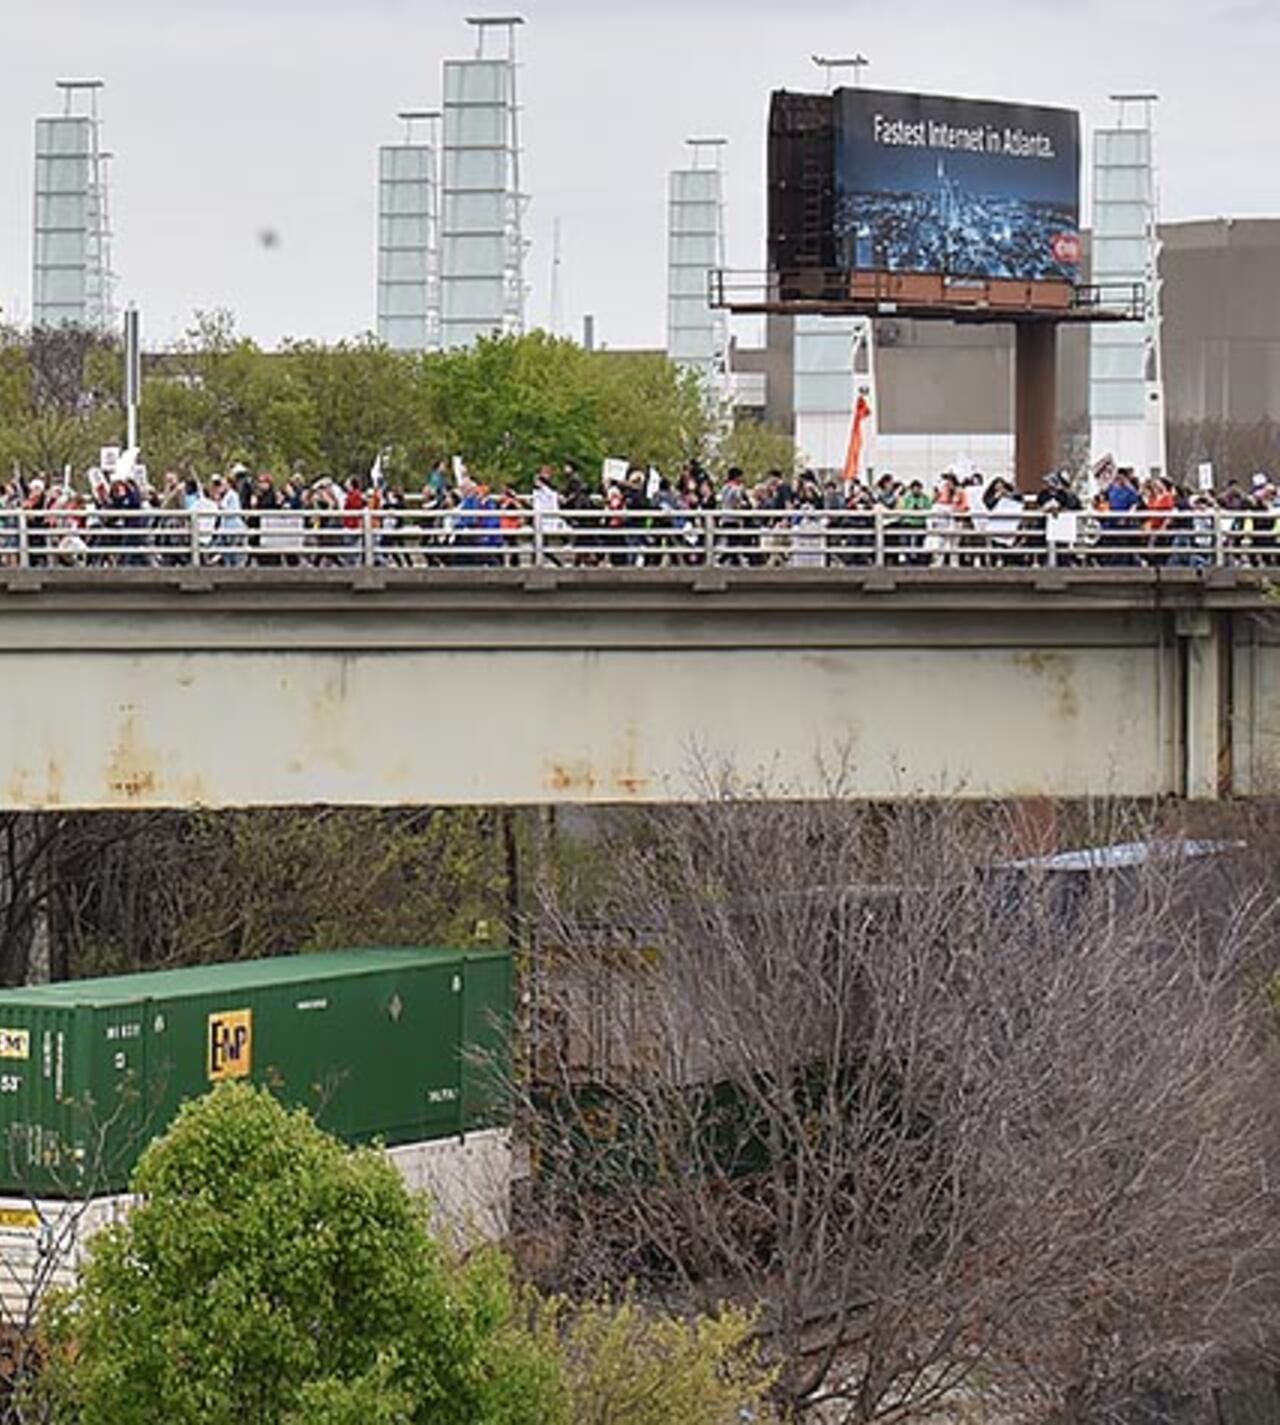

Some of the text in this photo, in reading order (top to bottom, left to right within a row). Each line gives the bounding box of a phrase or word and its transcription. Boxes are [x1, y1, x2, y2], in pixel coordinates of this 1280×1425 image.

[874, 114, 1055, 157] Fastest Internet in Atlanta.
[211, 1020, 248, 1073] EMP
